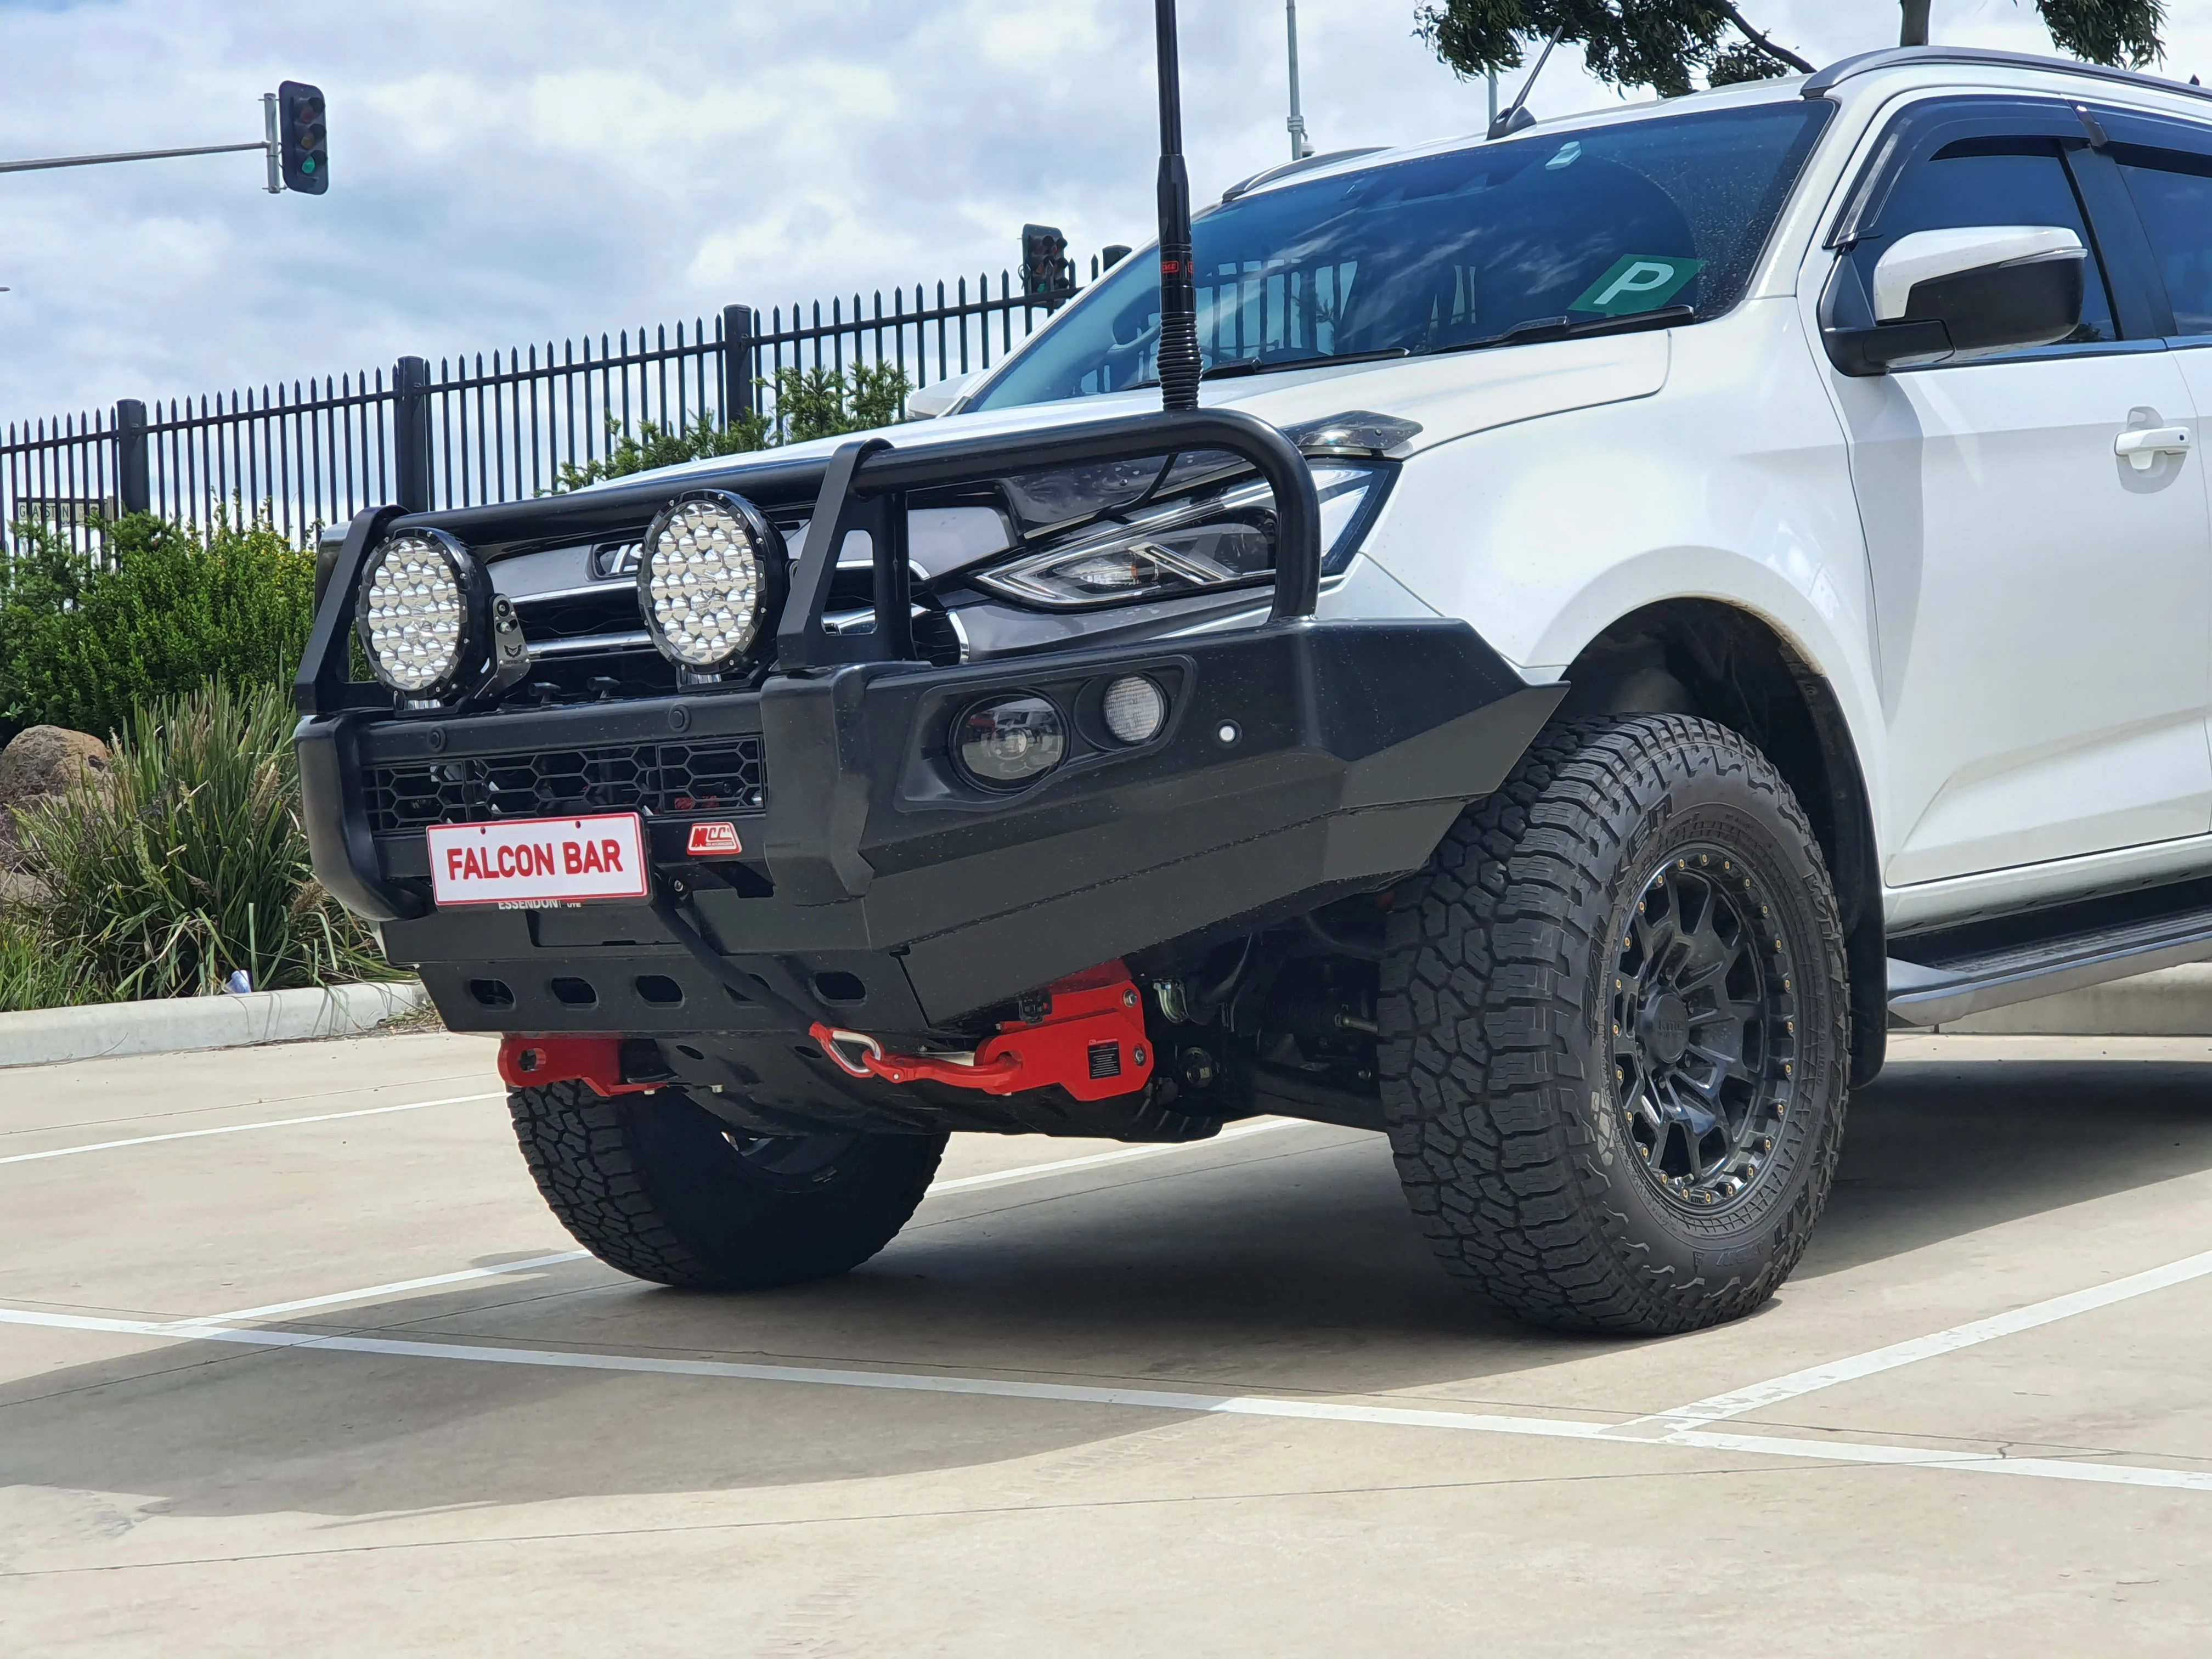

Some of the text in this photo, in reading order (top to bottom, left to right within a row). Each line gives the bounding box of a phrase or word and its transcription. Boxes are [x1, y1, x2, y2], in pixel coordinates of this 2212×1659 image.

[1594, 262, 1674, 304] P
[447, 839, 624, 880] FALCON BAR
[498, 900, 558, 910] ESSENDON
